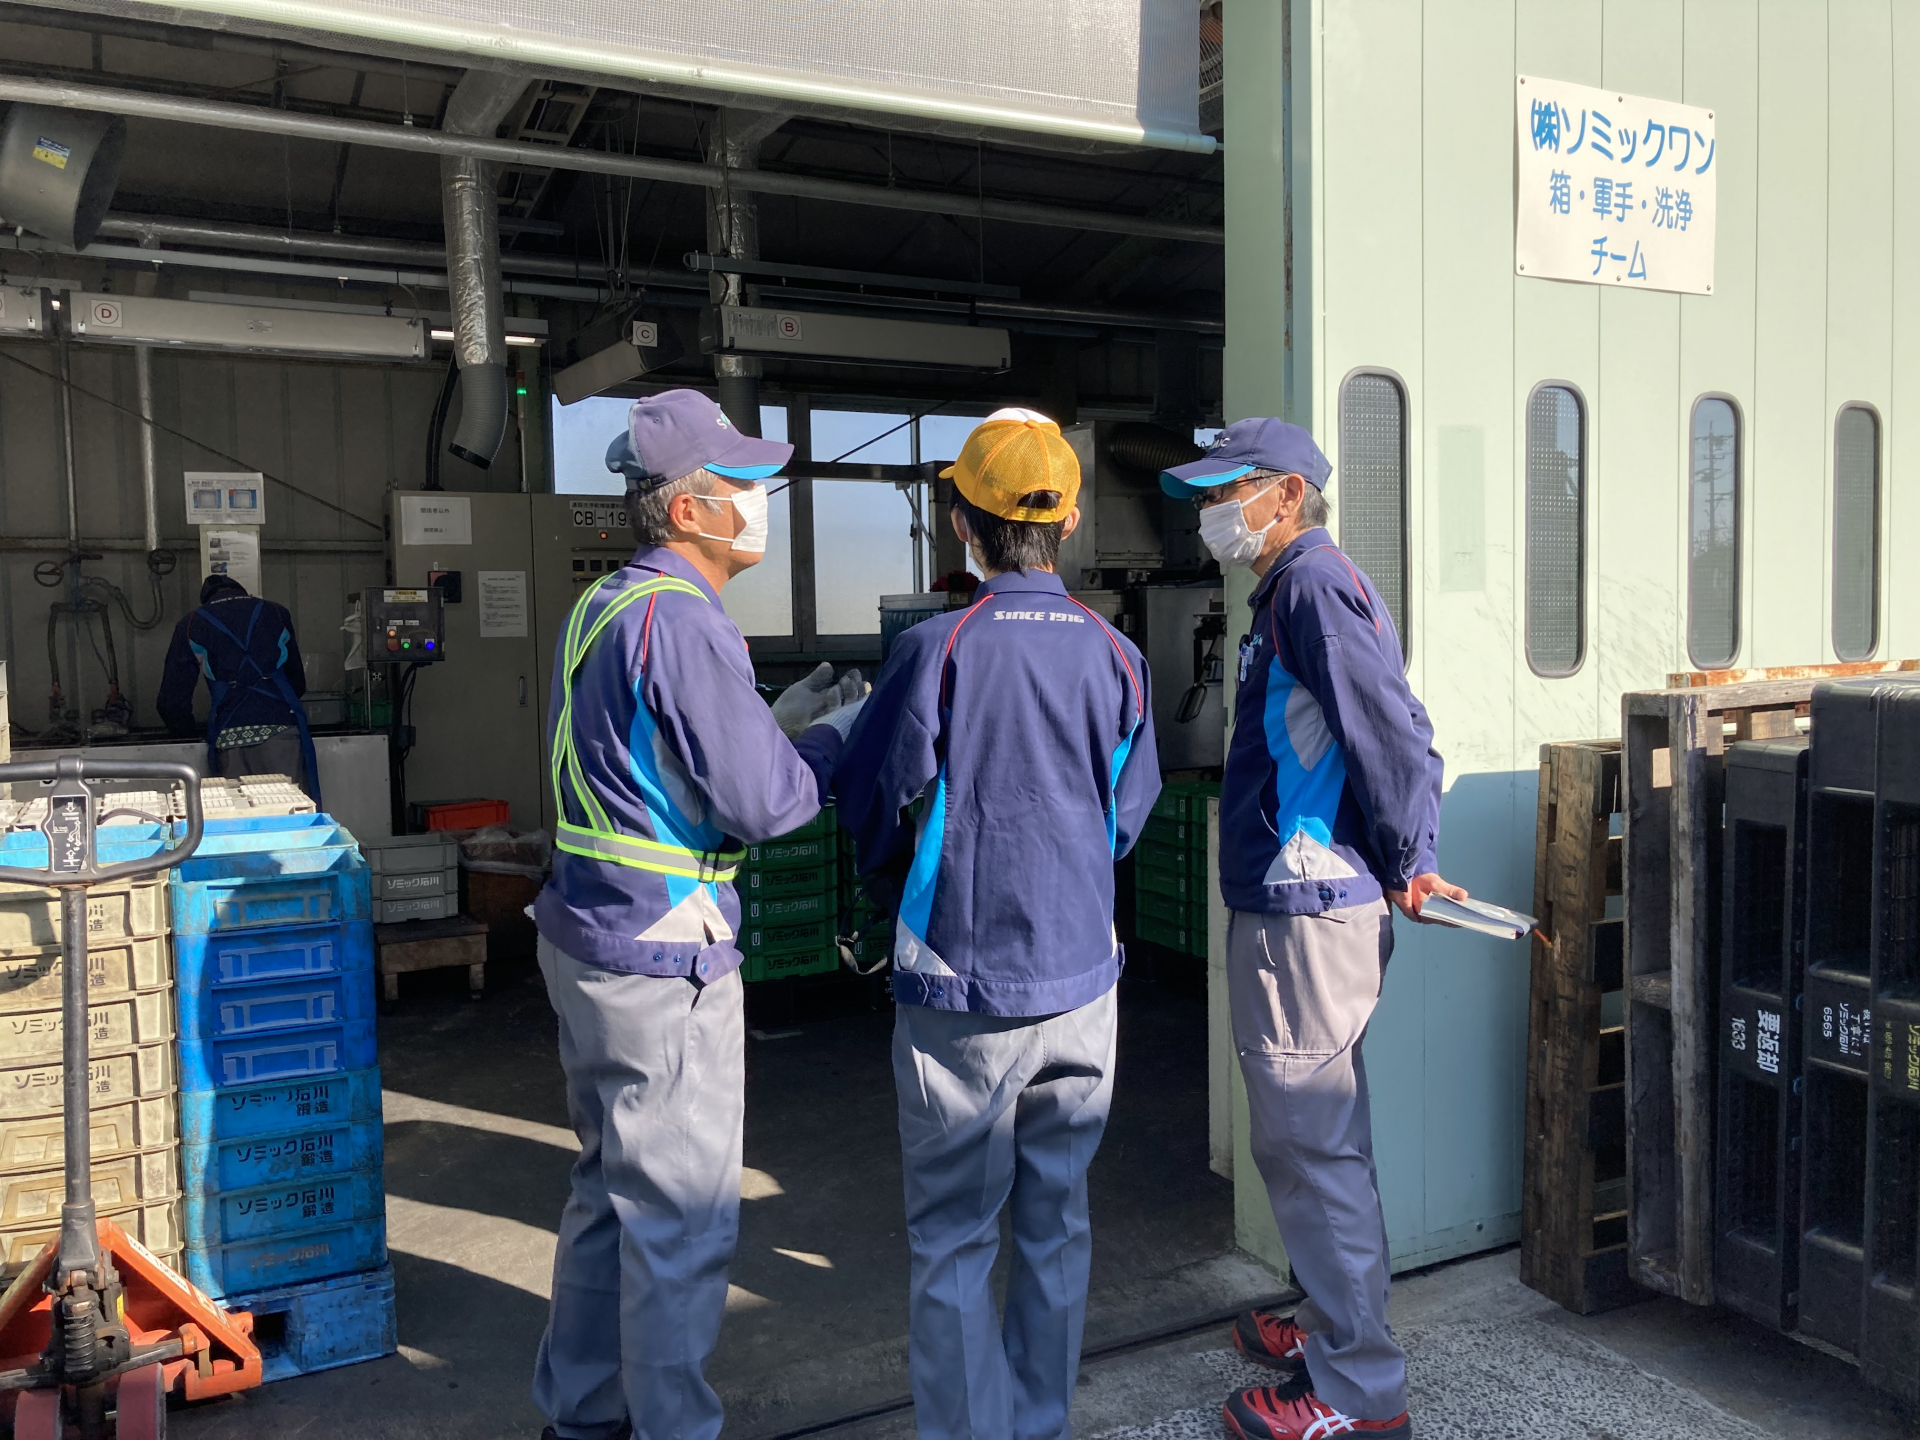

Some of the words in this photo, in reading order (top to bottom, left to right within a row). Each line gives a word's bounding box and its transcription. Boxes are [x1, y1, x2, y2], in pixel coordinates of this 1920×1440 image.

[1550, 169, 1693, 231] 箱・軍手・洗浄
[1590, 236, 1647, 281] チーム
[101, 308, 112, 319] D
[641, 330, 650, 339] C
[785, 322, 795, 332] B
[1049, 612, 1085, 624] 1916
[766, 845, 818, 858] ソミック石川
[387, 876, 440, 889] ソミック石川
[388, 900, 440, 912] ソミック石川
[766, 899, 818, 914] ソミック石川
[1823, 1006, 1833, 1038] 6565
[1839, 1002, 1850, 1055] ソミック石川
[1731, 1016, 1746, 1051] 1633
[1756, 1009, 1781, 1074] 要返却
[236, 1134, 334, 1163] ソミック石川
[238, 1186, 335, 1216] ソミック石川
